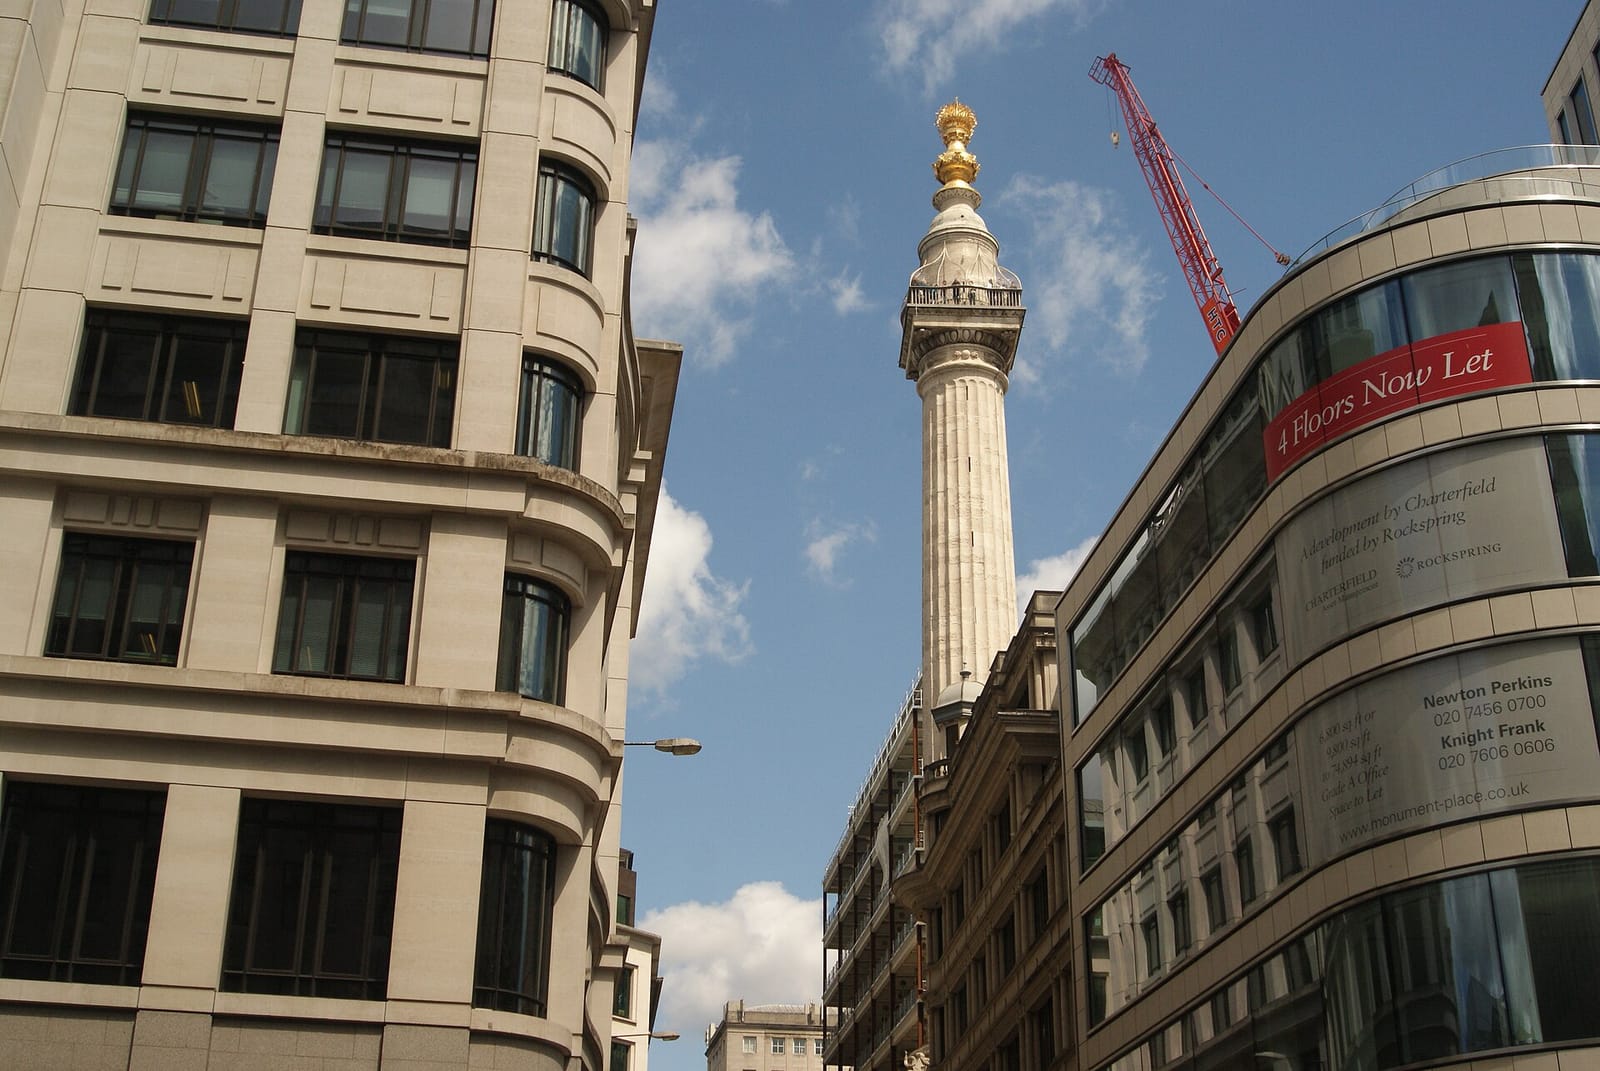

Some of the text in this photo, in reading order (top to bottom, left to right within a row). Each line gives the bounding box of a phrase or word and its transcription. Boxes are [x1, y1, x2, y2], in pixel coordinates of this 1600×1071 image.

[1207, 307, 1227, 343] HTC
[1278, 348, 1494, 455] 4 Floors Now Let
[1309, 512, 1380, 557] development
[1384, 504, 1401, 521] by
[1405, 476, 1496, 513] Charterfield
[1321, 511, 1467, 575] funded by Rockspring
[1416, 543, 1502, 571] ROCKSPRING
[1303, 569, 1378, 613] CHARTERFIELD
[1423, 675, 1553, 710] Newton Perkins
[1364, 710, 1377, 722] or
[1433, 694, 1546, 727] 020 7456 0700
[1441, 719, 1546, 750] Knight Frank
[1438, 738, 1555, 770] 020 7606 0606
[1321, 780, 1346, 802] Grade
[1357, 764, 1390, 785] Office
[1353, 796, 1364, 807] to
[1366, 786, 1383, 802] Let
[1339, 782, 1530, 844] www.monument-place.co.uk
